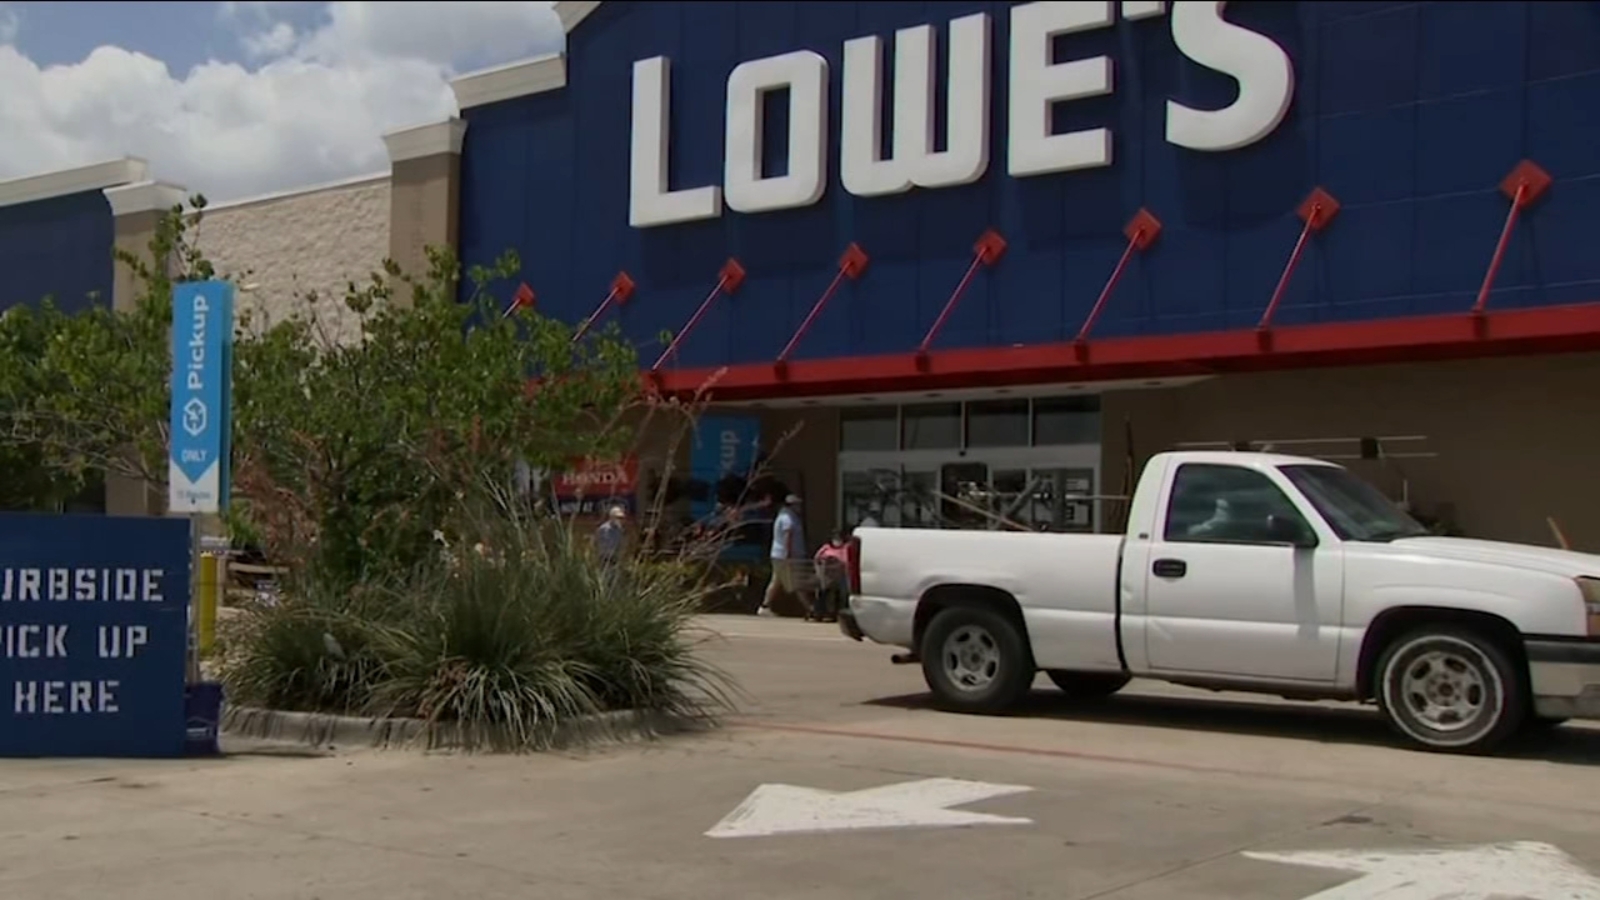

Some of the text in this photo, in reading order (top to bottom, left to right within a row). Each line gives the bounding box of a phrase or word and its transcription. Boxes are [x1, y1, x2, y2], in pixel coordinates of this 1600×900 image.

[629, 0, 1294, 226] LOWE'S
[187, 295, 209, 390] Pickup
[562, 469, 629, 485] HONDA
[0, 625, 148, 658] ICK UP
[14, 680, 120, 713] HERE
